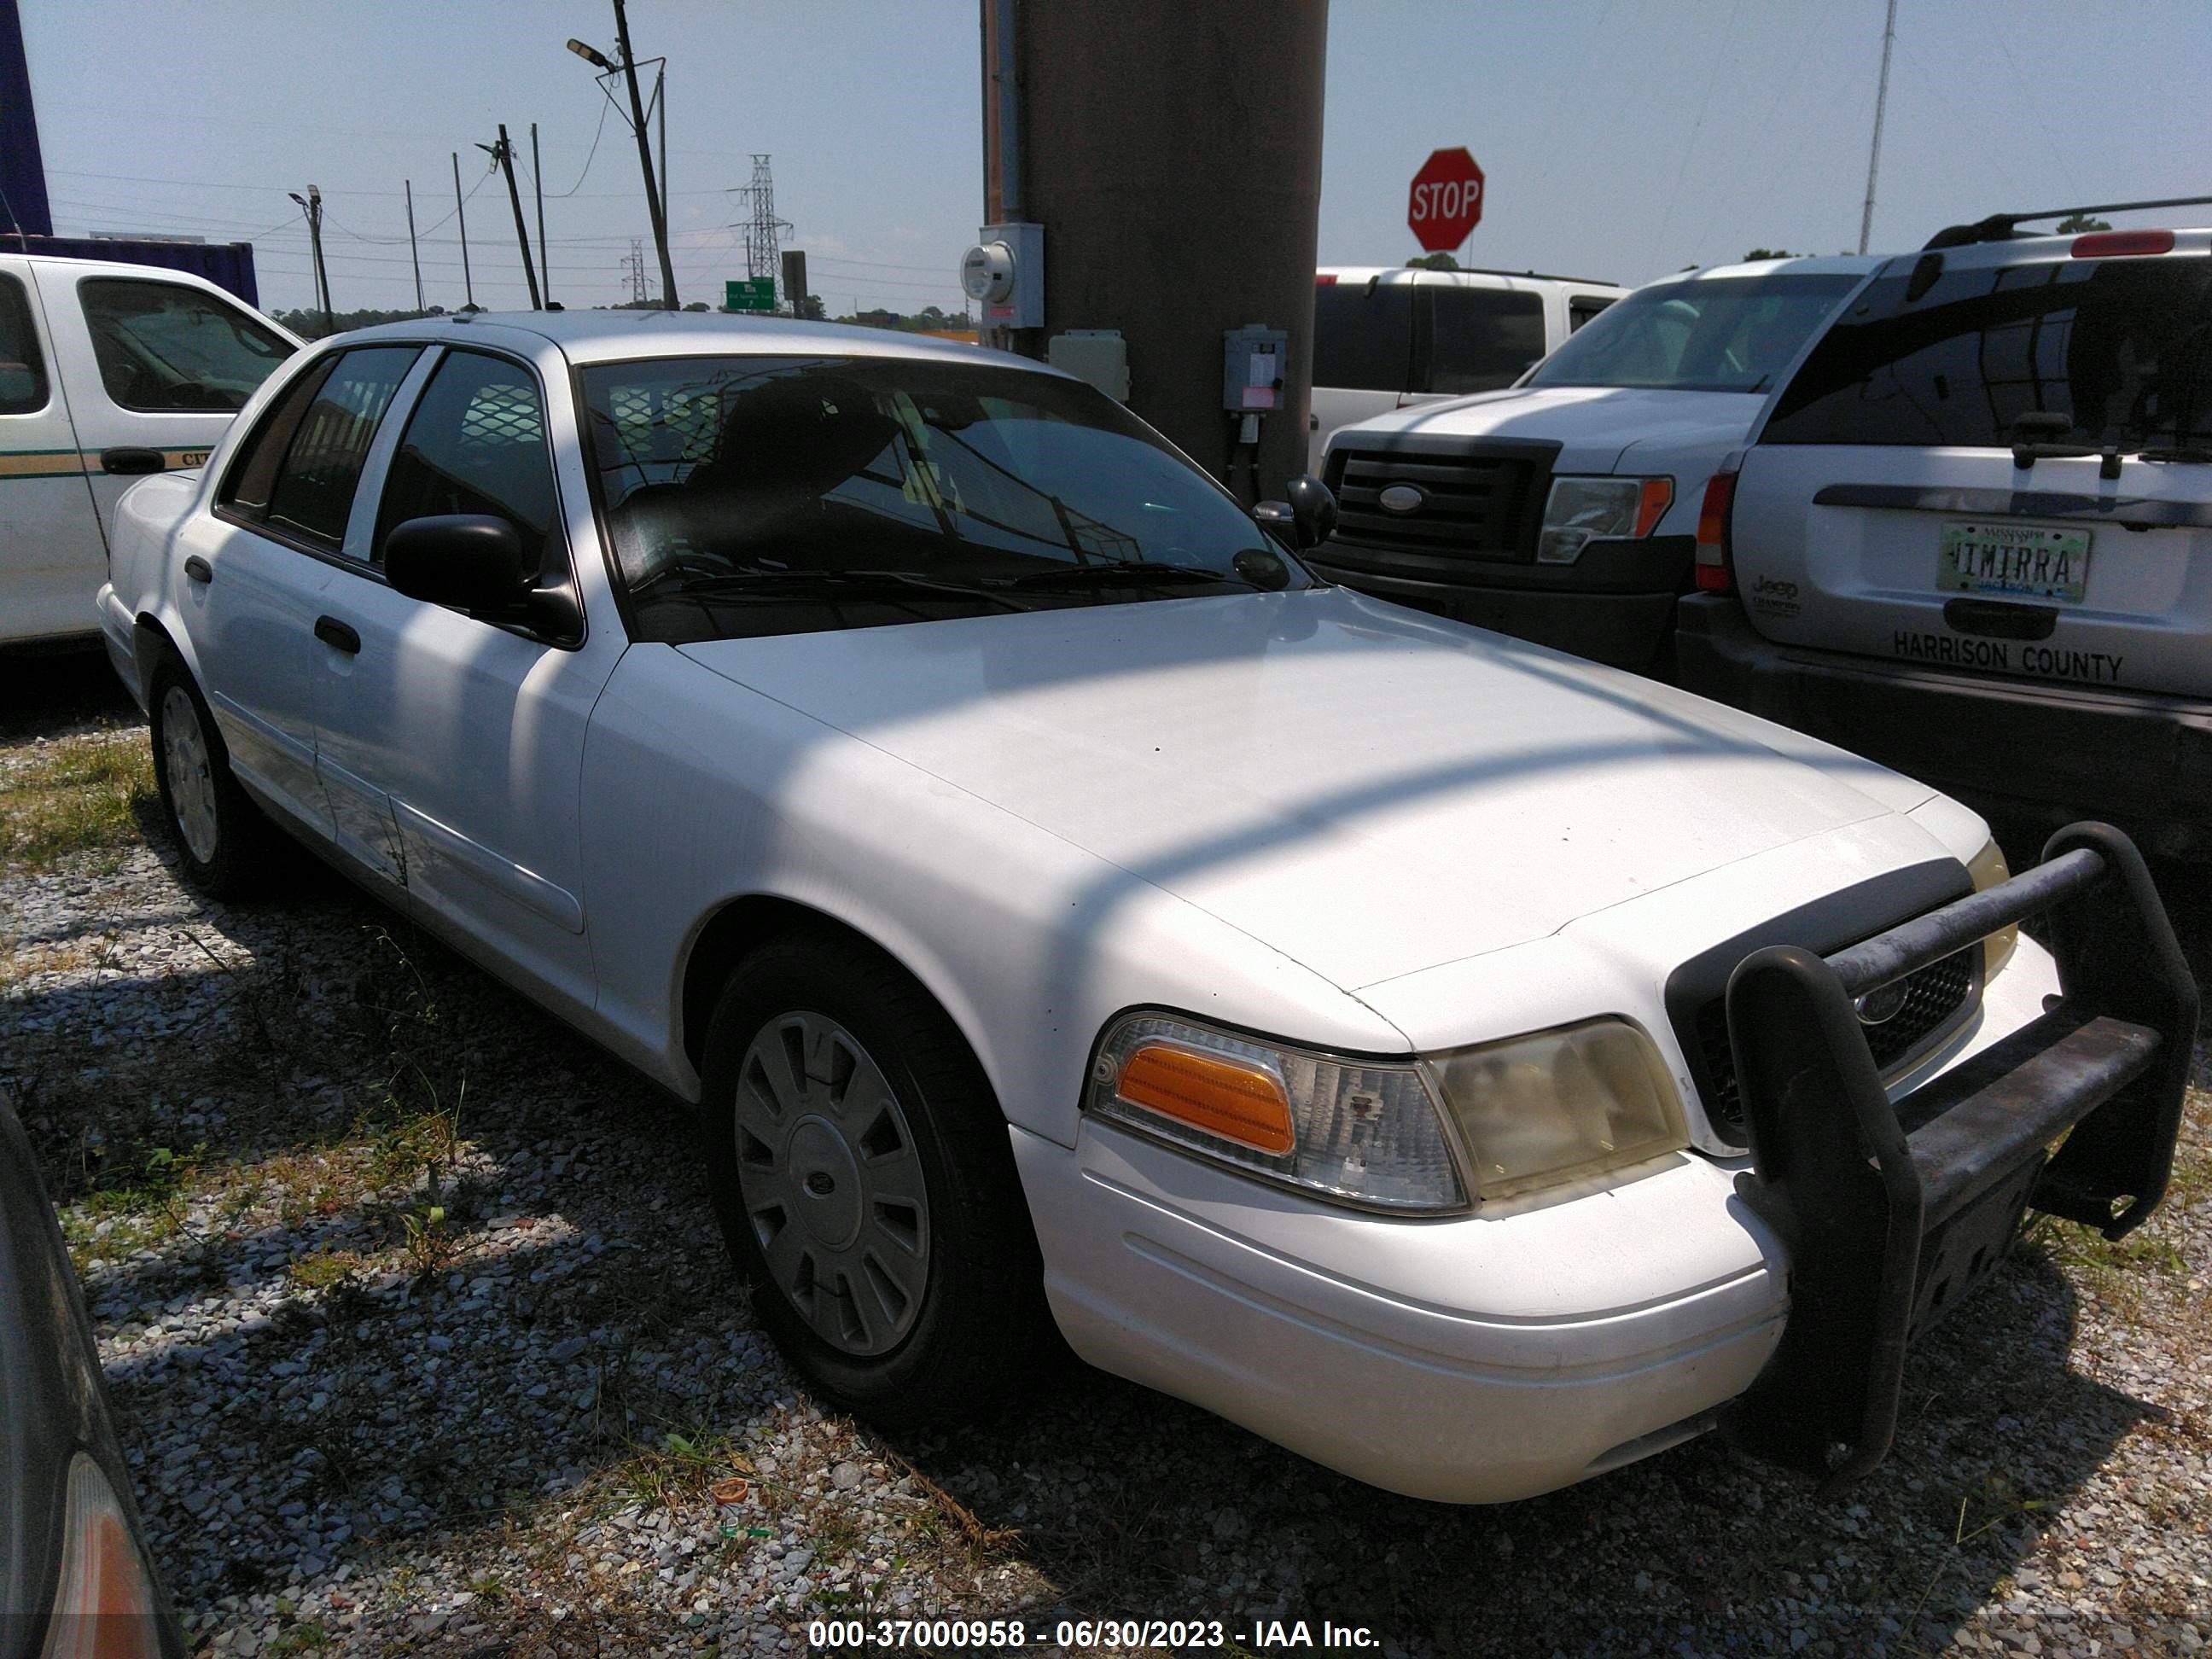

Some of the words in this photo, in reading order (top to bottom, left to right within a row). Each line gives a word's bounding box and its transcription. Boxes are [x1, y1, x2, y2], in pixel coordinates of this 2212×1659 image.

[1412, 179, 1480, 221] STOP
[1751, 573, 1799, 599] Jeep
[1894, 630, 2008, 668] HARRISON
[2023, 646, 2124, 681] COUNTY
